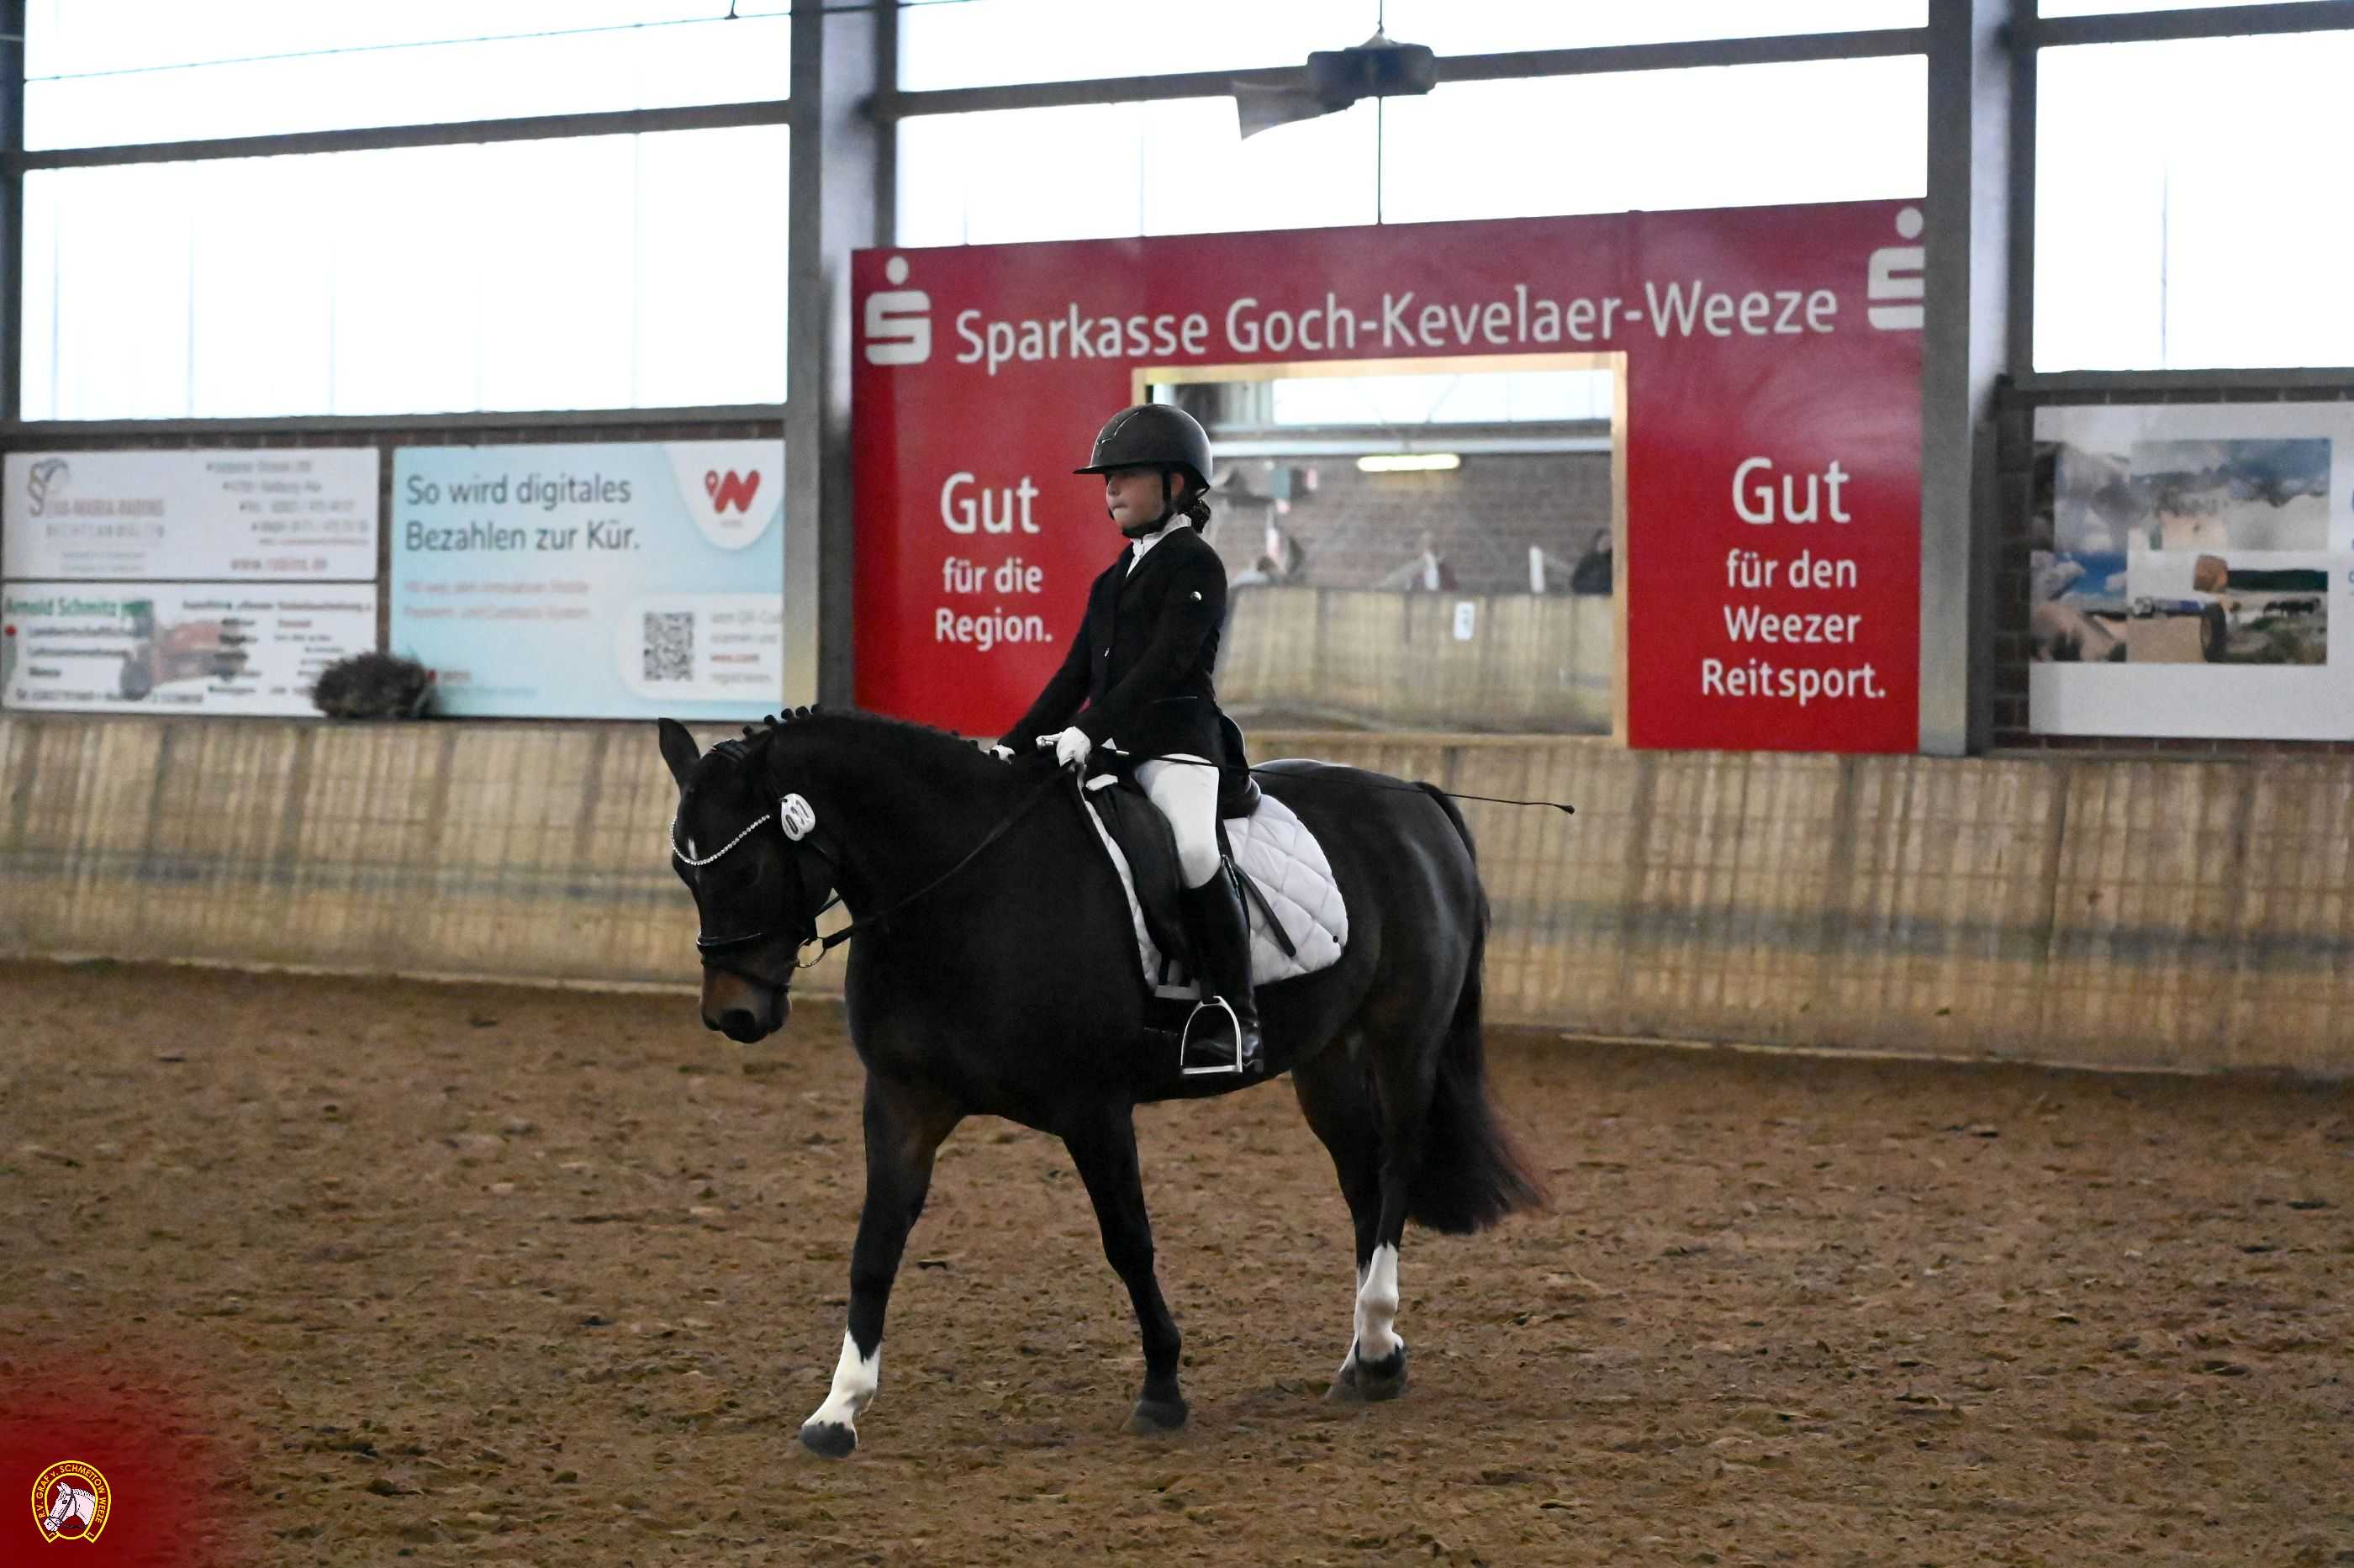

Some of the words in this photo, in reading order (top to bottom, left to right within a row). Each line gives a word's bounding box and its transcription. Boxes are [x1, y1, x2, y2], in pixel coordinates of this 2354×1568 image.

[956, 303, 1209, 376] Sparkasse
[1226, 280, 1838, 352] Goch-Kevelaer-Weeze
[406, 474, 441, 506] So
[448, 474, 509, 505] wird
[515, 473, 631, 512] digitales
[940, 472, 1041, 534] Gut
[1732, 457, 1851, 525] Gut
[404, 519, 526, 552] Bezahlen
[535, 526, 579, 552] zur
[587, 517, 641, 552] Kür.
[942, 556, 987, 594] für
[994, 557, 1043, 594] die
[1726, 547, 1779, 589] für
[1788, 548, 1857, 589] den
[935, 606, 1053, 652] Region.
[1723, 604, 1861, 643] Weezer
[1701, 657, 1886, 707] Reitsport.
